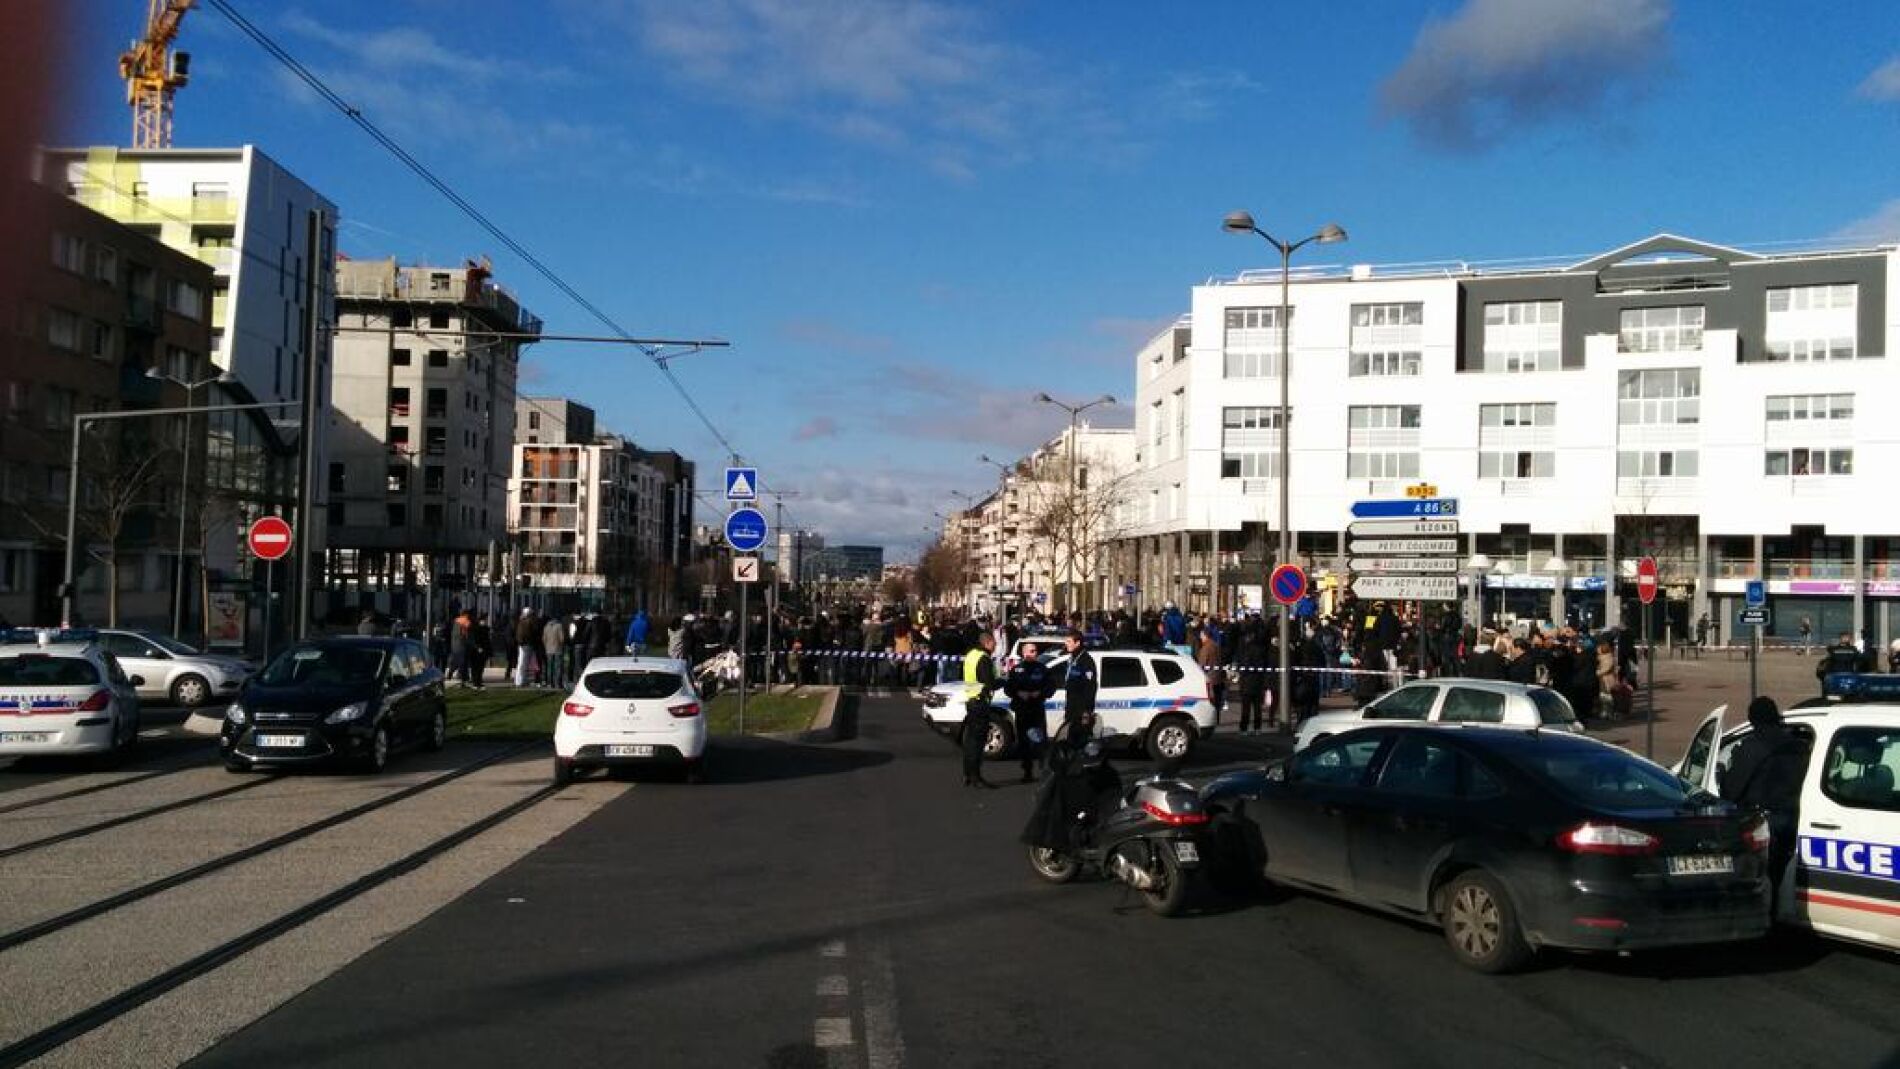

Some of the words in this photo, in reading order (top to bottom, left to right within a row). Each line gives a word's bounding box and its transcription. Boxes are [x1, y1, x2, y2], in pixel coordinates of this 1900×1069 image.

[1413, 504, 1421, 513] A
[1424, 503, 1439, 513] 86
[1415, 524, 1454, 532] BEZONS
